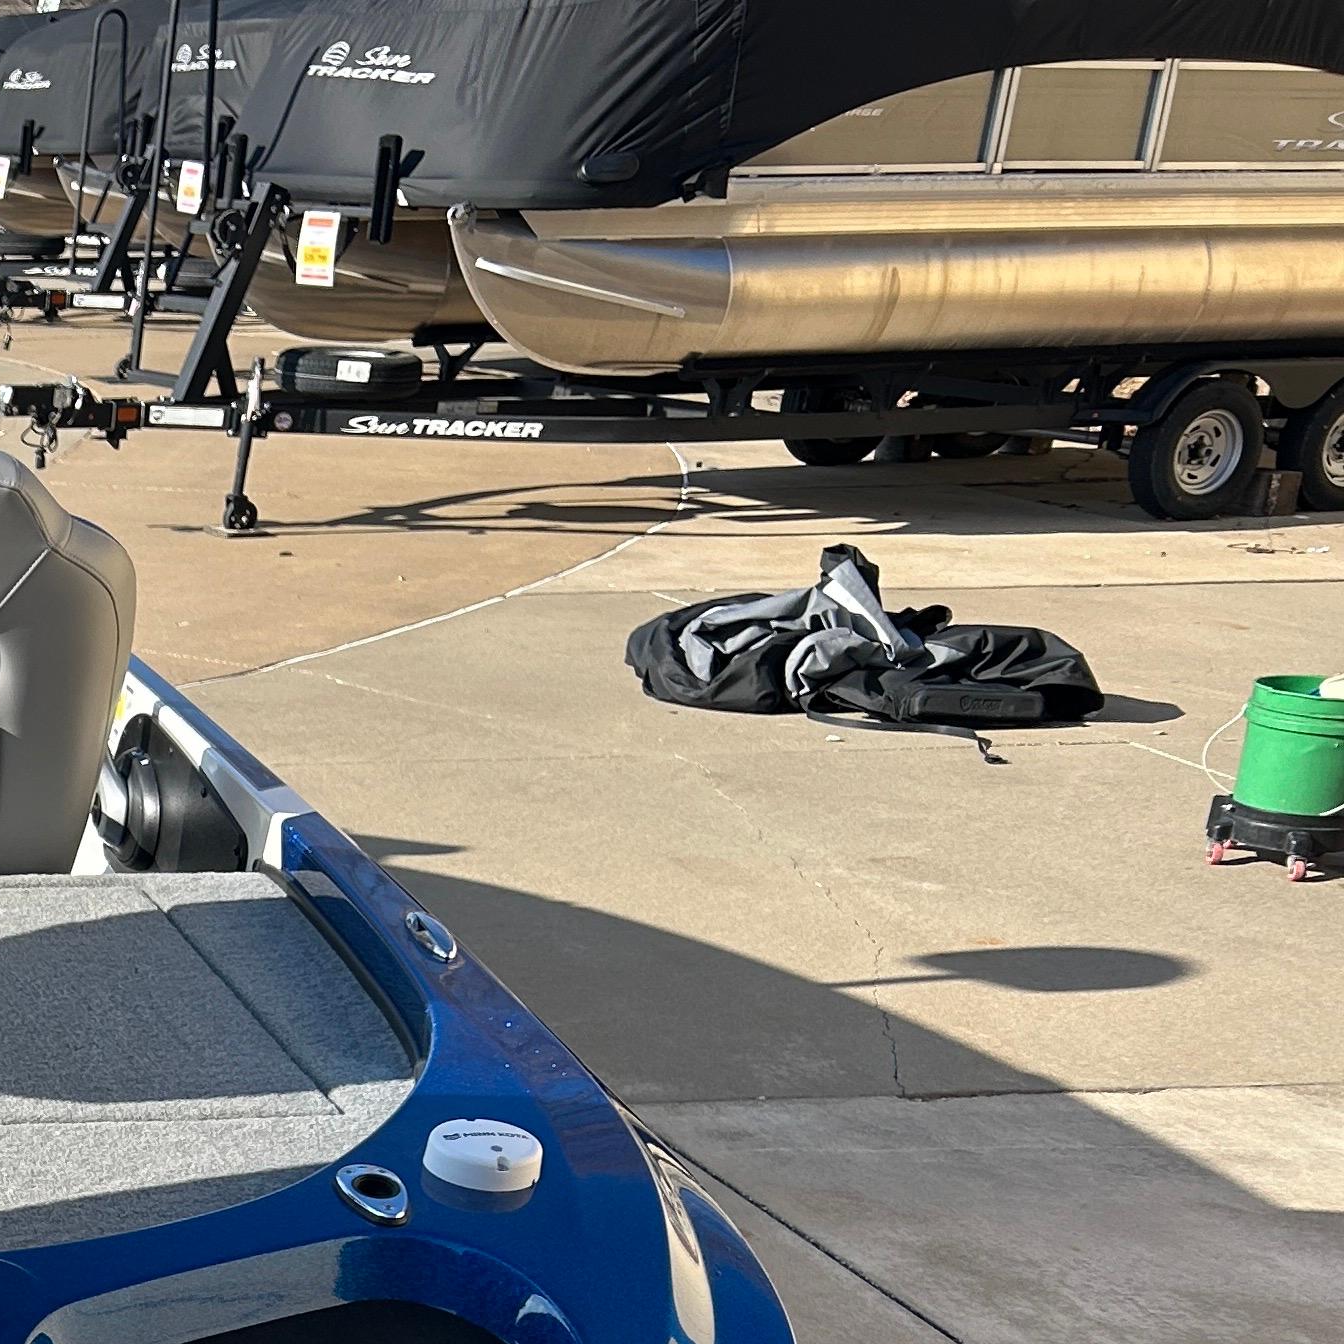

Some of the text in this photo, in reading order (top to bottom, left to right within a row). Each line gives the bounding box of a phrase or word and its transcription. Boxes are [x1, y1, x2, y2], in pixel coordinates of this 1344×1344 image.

[354, 45, 413, 68] Sun
[306, 63, 437, 84] TRACKER
[340, 415, 544, 439] Sun TRACKER
